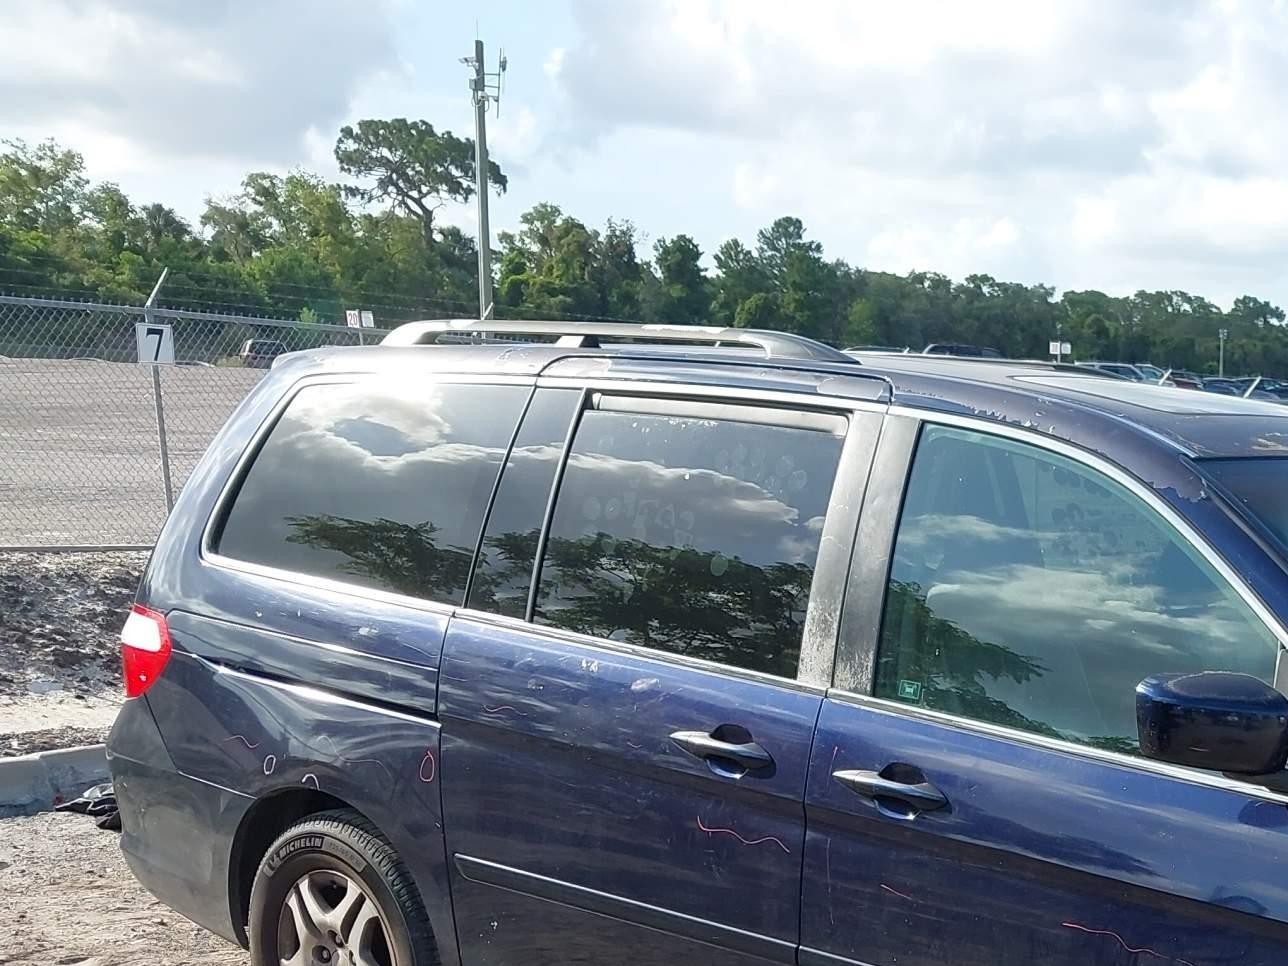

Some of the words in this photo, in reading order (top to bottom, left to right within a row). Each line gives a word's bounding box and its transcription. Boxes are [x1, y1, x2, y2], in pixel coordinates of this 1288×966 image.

[348, 312, 358, 326] 20
[146, 327, 164, 362] 7
[279, 837, 322, 858] MICHELIN
